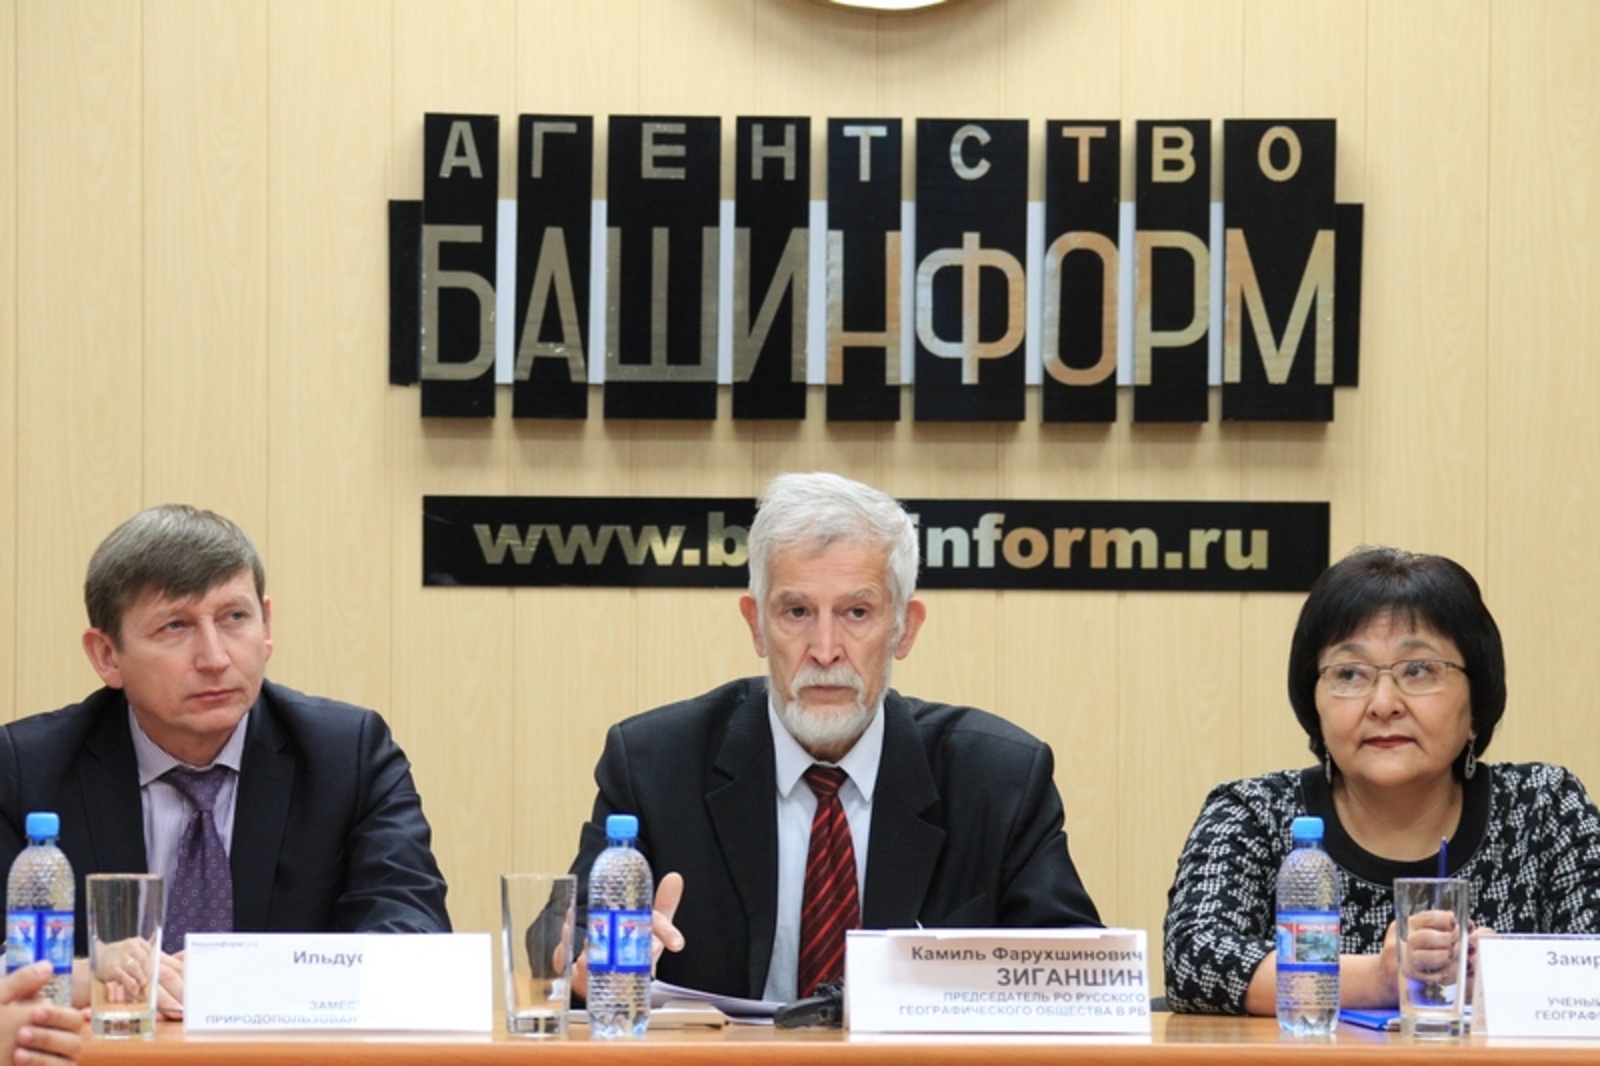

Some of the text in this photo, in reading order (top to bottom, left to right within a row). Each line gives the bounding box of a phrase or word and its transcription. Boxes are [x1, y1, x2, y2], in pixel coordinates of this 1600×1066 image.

[439, 121, 1301, 182] АГЕНТСТВО
[420, 224, 1335, 385] БАШИНФОРМ
[473, 512, 1268, 570] www.bnform.ru
[911, 946, 1142, 964] Камиль Фарухшинович
[997, 967, 1143, 986] ЗИГАНШИН
[310, 1000, 359, 1011] ЗАМЕС
[943, 991, 1146, 1003] ПРЕДСЕДАТЕЛЬ РО РУССКОГО
[899, 1005, 1146, 1017] ГЕОГРАФИЧЕСКОГО ОБЩЕСТВА В РБ
[1535, 1010, 1600, 1020] ГЕОГРАФ
